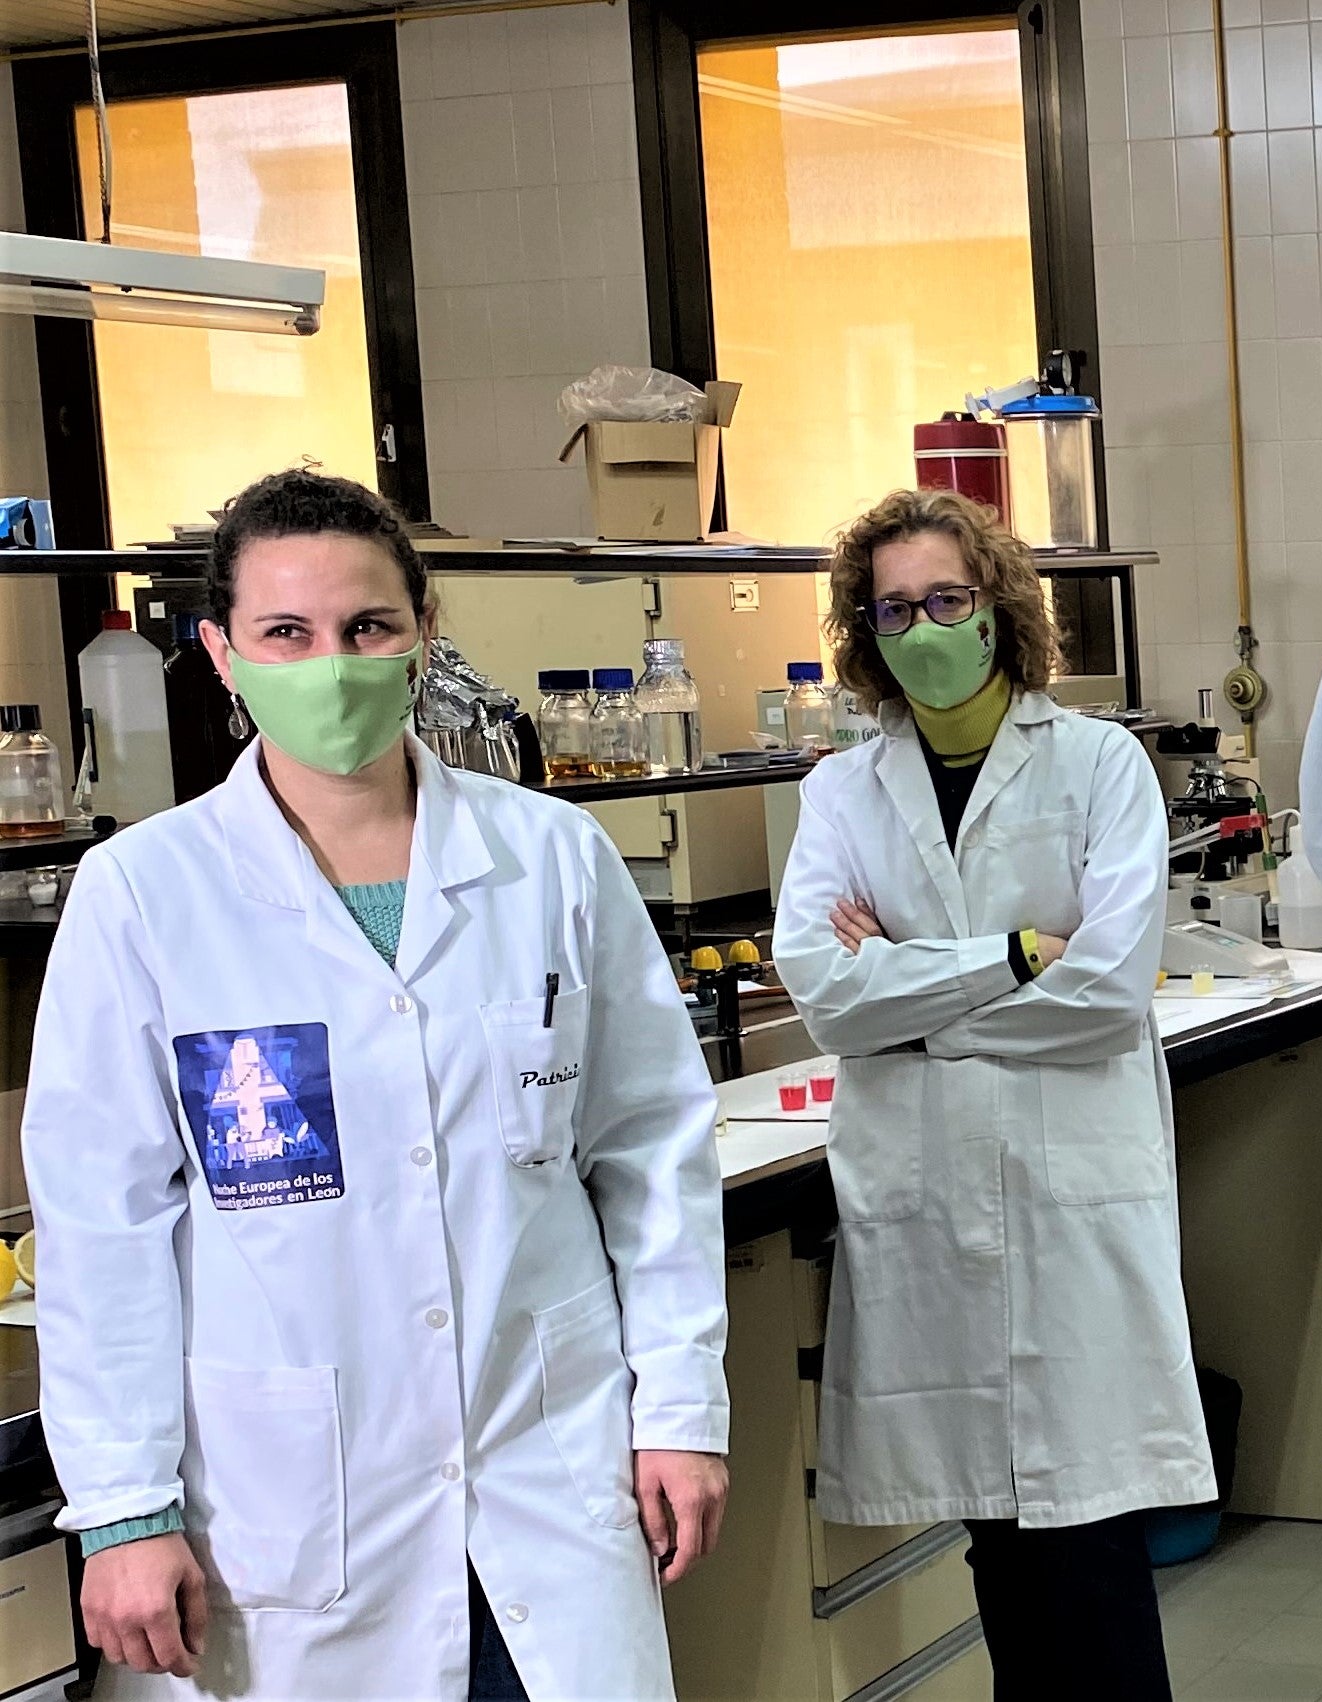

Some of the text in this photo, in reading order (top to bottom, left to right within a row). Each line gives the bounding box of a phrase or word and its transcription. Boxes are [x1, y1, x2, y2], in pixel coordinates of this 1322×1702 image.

[519, 1063, 580, 1089] Patrici
[239, 1179, 291, 1195] Europea
[293, 1174, 310, 1188] de
[313, 1173, 333, 1185] los
[287, 1192, 304, 1203] en
[307, 1186, 341, 1200] León
